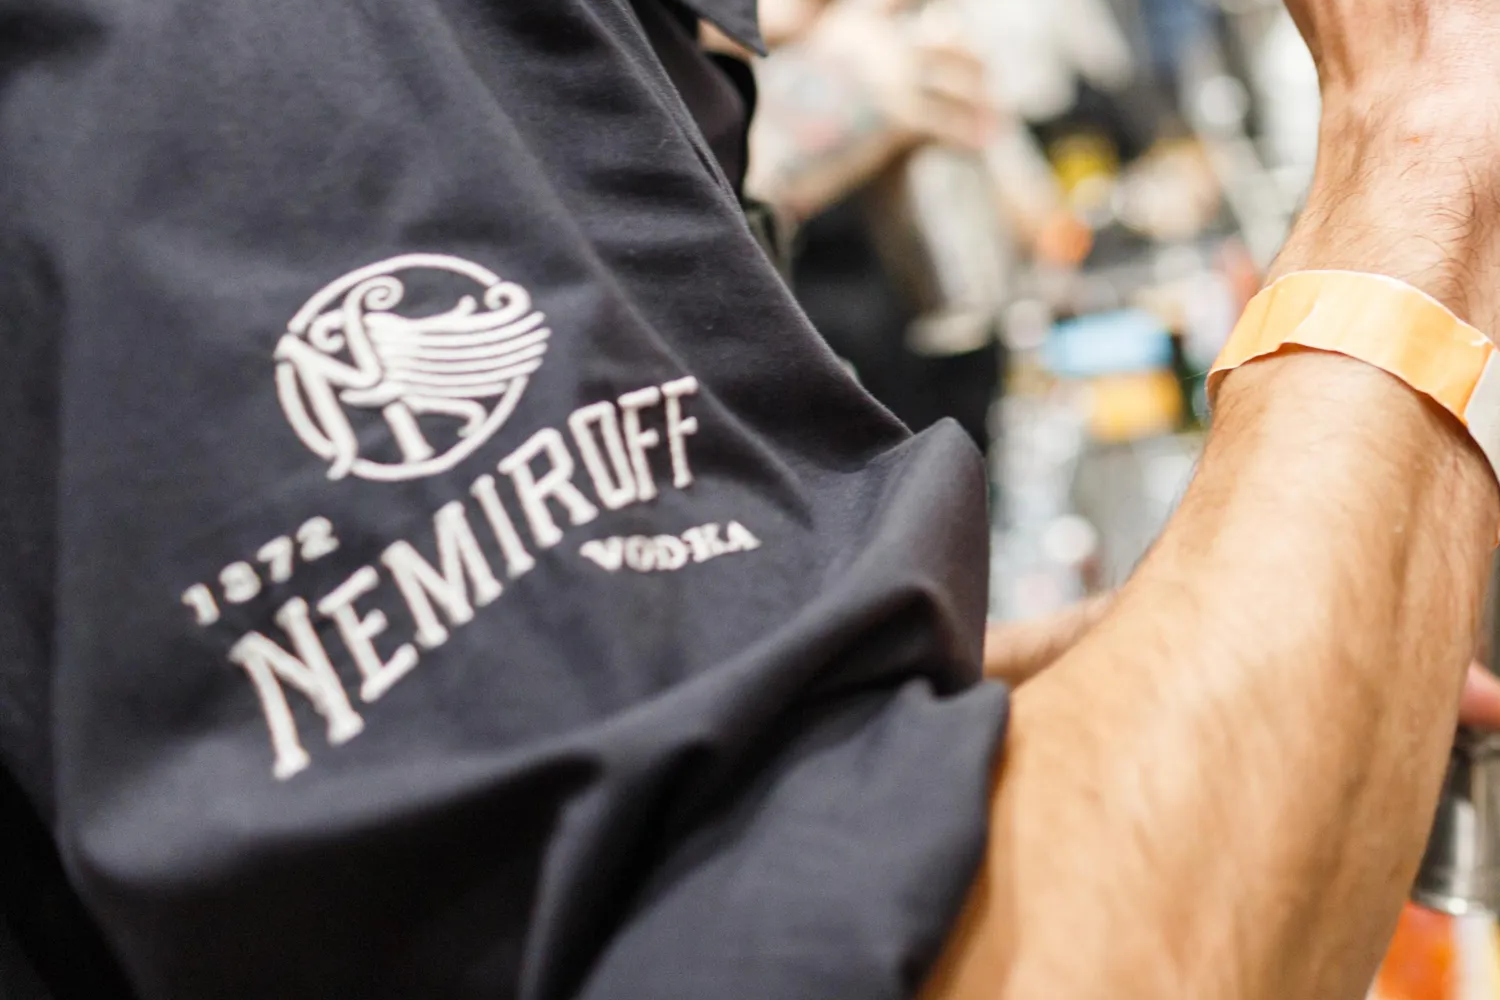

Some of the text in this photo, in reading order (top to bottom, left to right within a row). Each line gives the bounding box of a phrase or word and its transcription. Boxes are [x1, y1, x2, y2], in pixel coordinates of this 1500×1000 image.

[182, 516, 340, 625] 1872
[230, 375, 699, 781] NEMIROFF
[579, 520, 762, 573] VODKA
